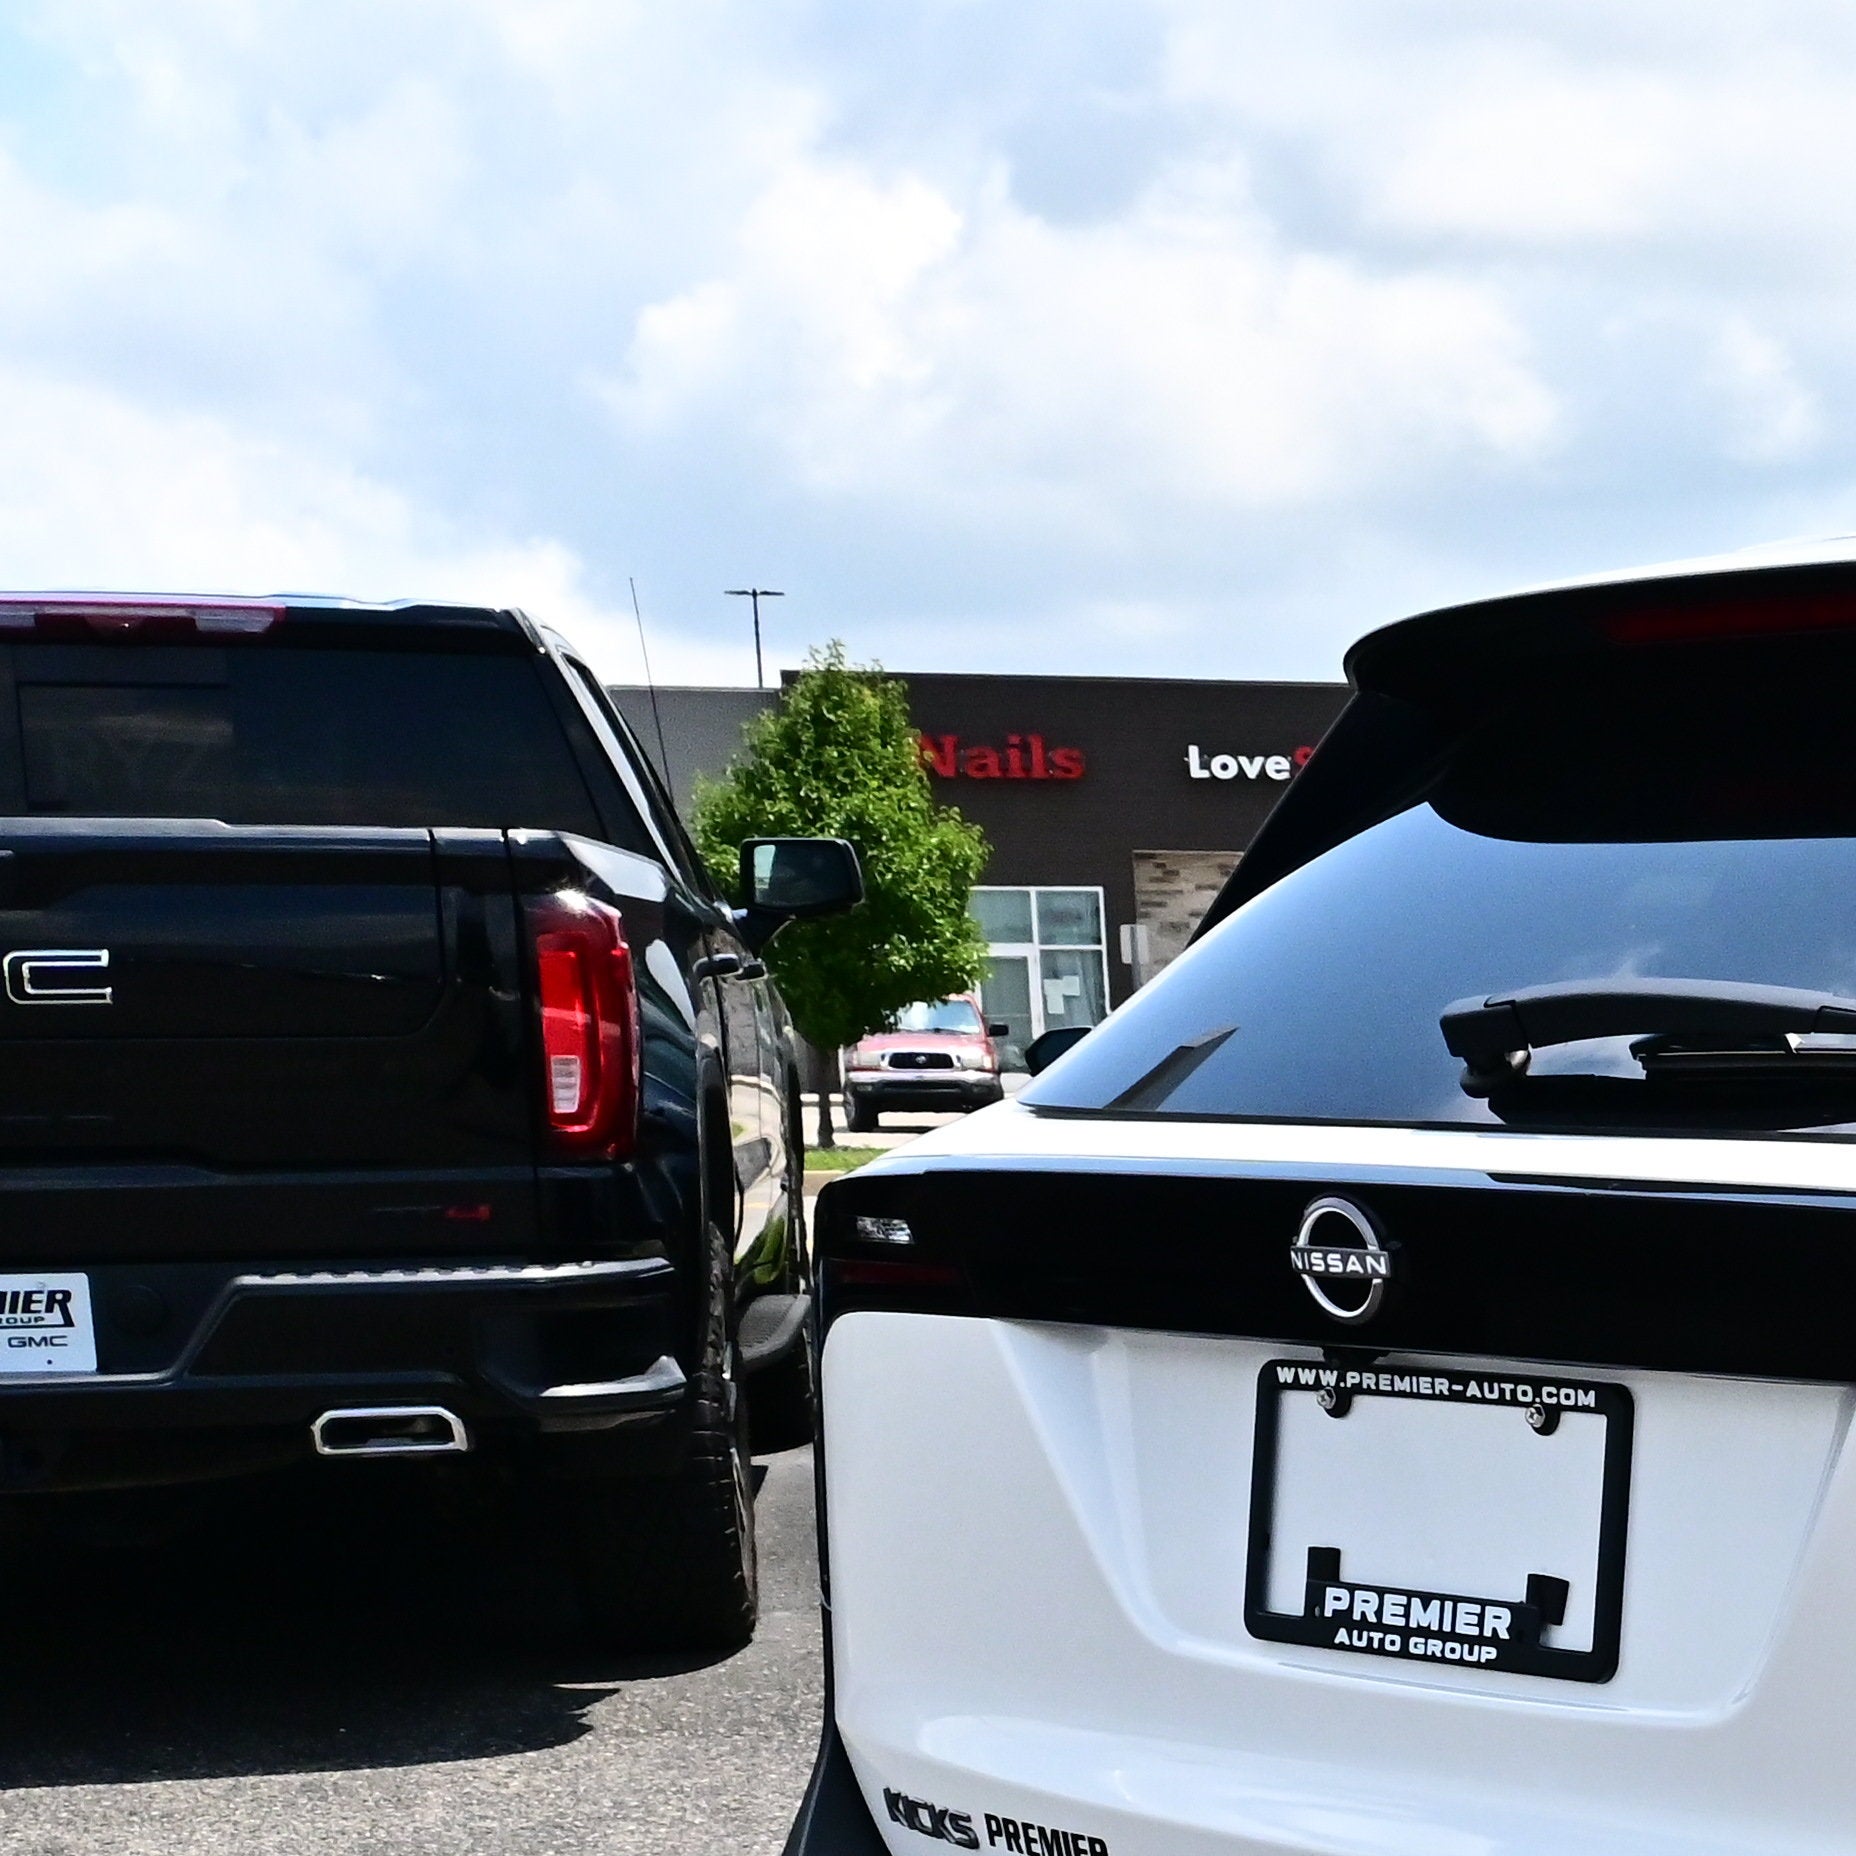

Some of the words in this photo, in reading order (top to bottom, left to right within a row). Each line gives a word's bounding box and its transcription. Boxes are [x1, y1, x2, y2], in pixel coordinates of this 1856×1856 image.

[915, 733, 1085, 780] Nails
[1290, 1250, 1387, 1275] NISSAN
[8, 1335, 68, 1348] GMC
[1276, 1366, 1596, 1408] WWW.PREMIER-AUTO.COM
[1324, 1586, 1512, 1640] PREMIER
[1333, 1627, 1401, 1652] AUTO
[1408, 1636, 1497, 1663] GROUP
[883, 1787, 980, 1850] KICKS
